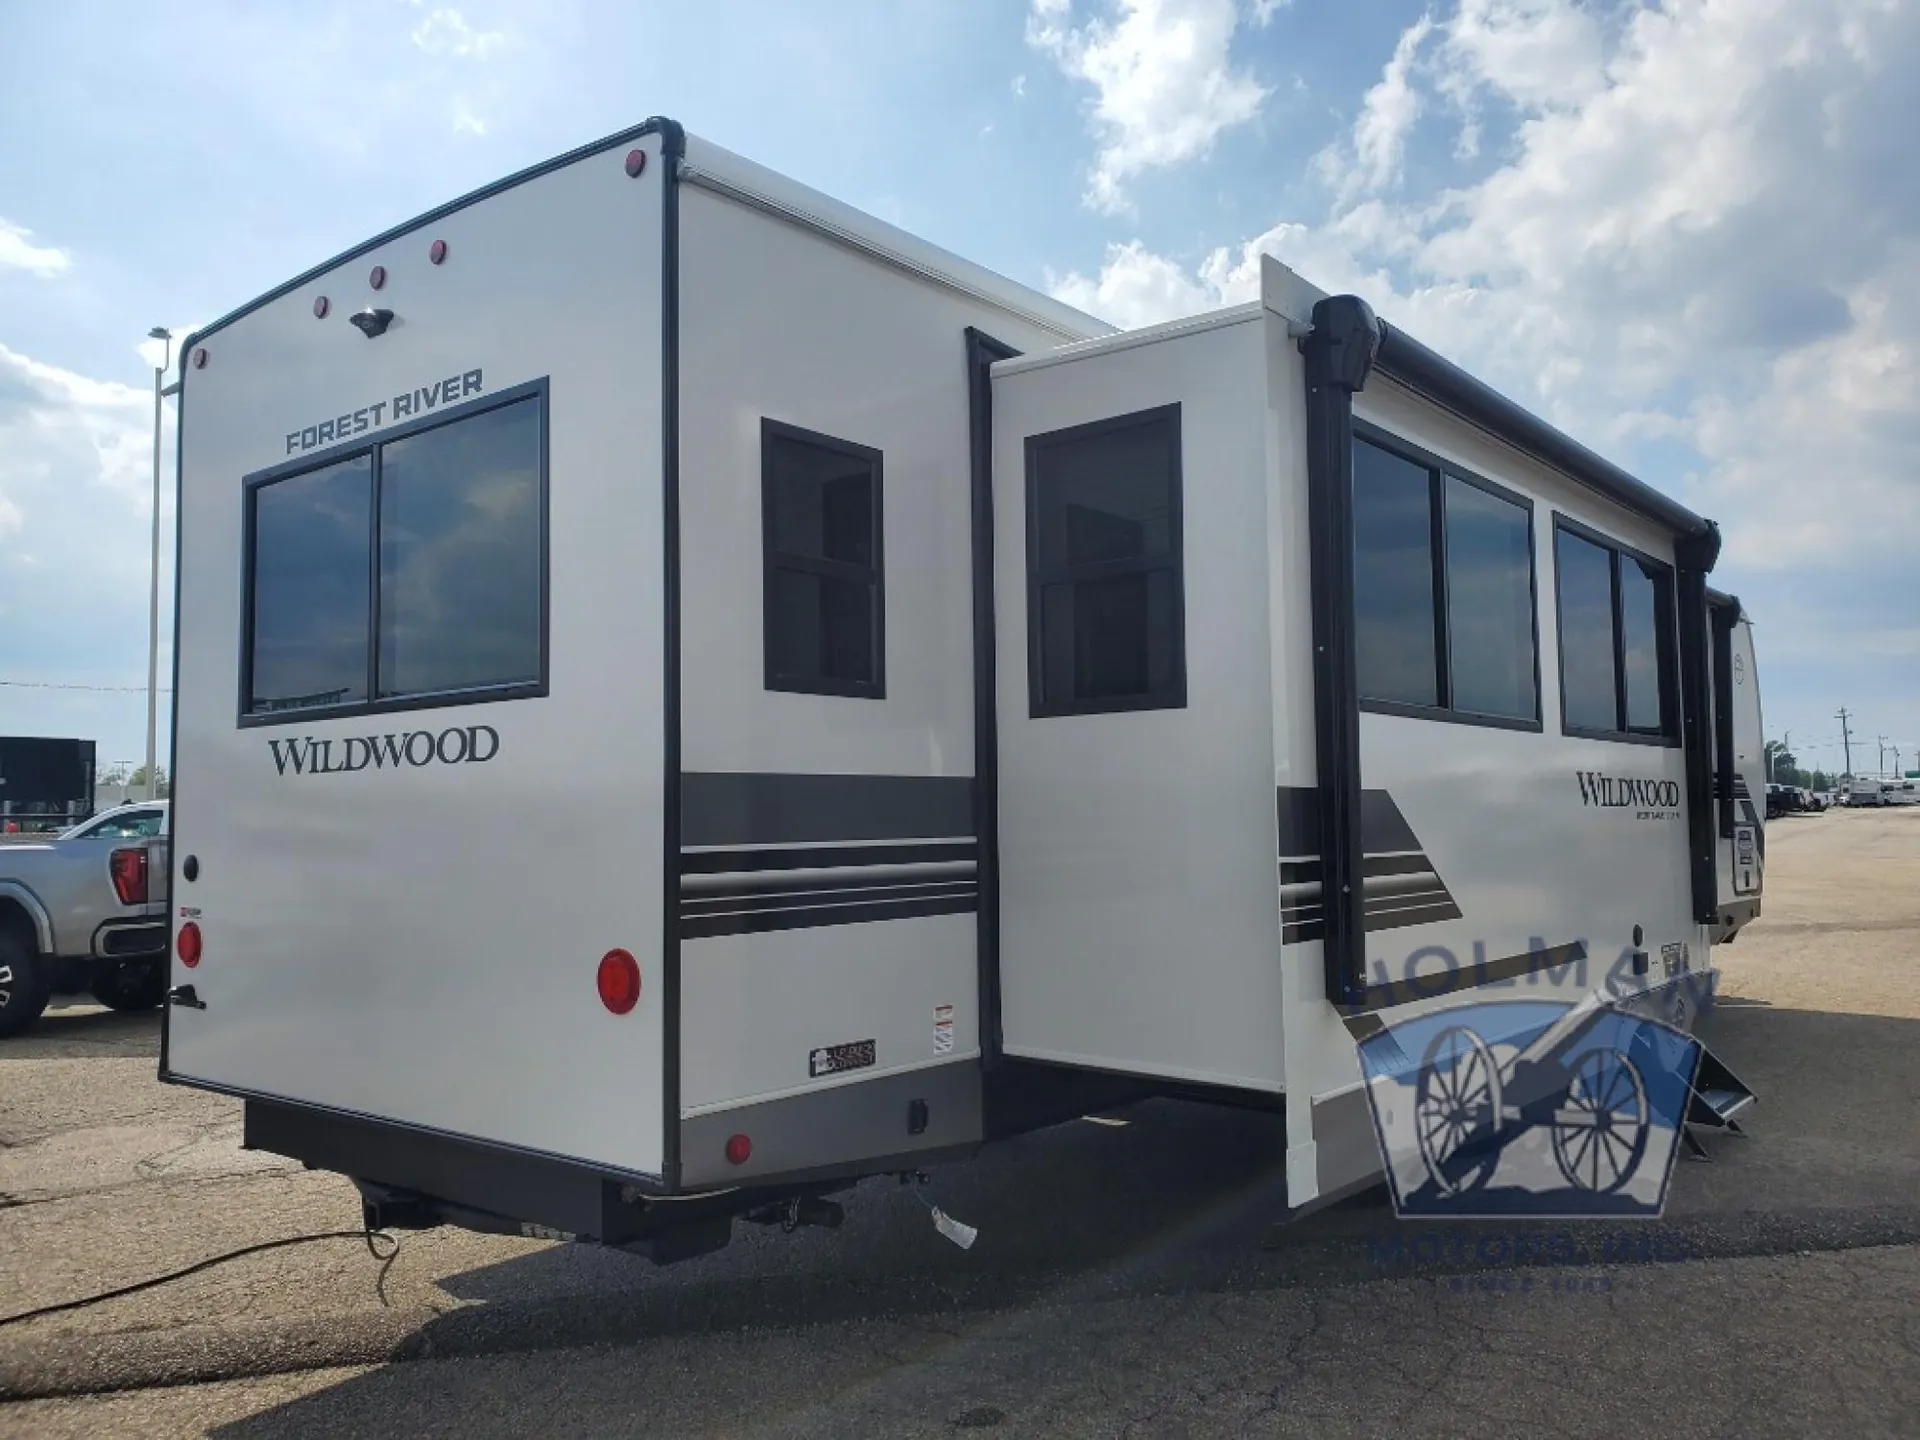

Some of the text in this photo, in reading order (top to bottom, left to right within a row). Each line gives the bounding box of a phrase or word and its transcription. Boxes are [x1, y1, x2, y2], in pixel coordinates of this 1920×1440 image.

[286, 368, 483, 455] FOREST RIVER
[268, 725, 500, 776] WILDWOOD
[1576, 771, 1679, 807] WILDWOOD
